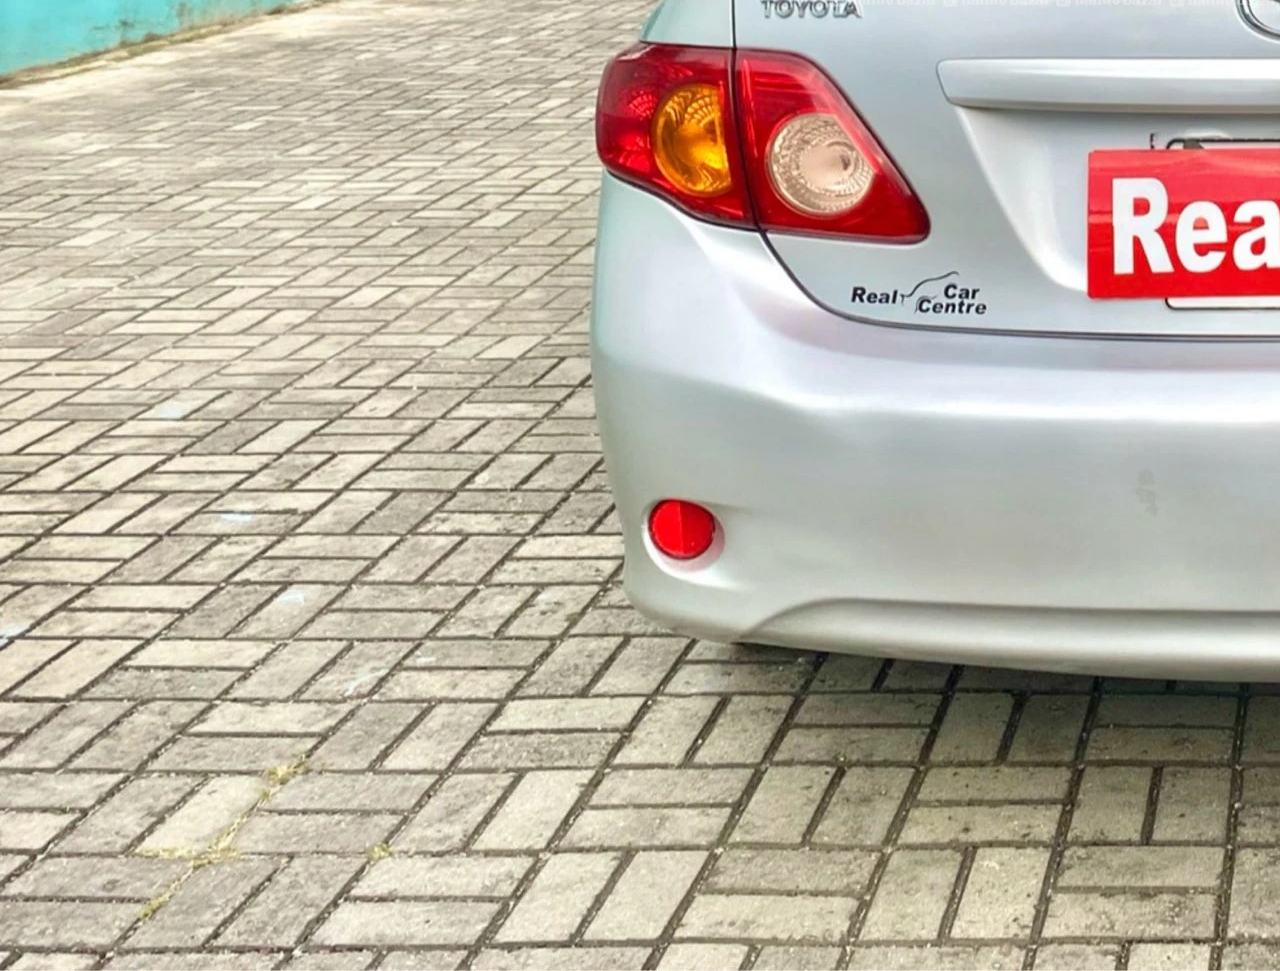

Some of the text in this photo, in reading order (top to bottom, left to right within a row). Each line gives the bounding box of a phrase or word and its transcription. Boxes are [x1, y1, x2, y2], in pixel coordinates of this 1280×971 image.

[851, 283, 980, 304] Real Car
[918, 298, 987, 315] Centre
